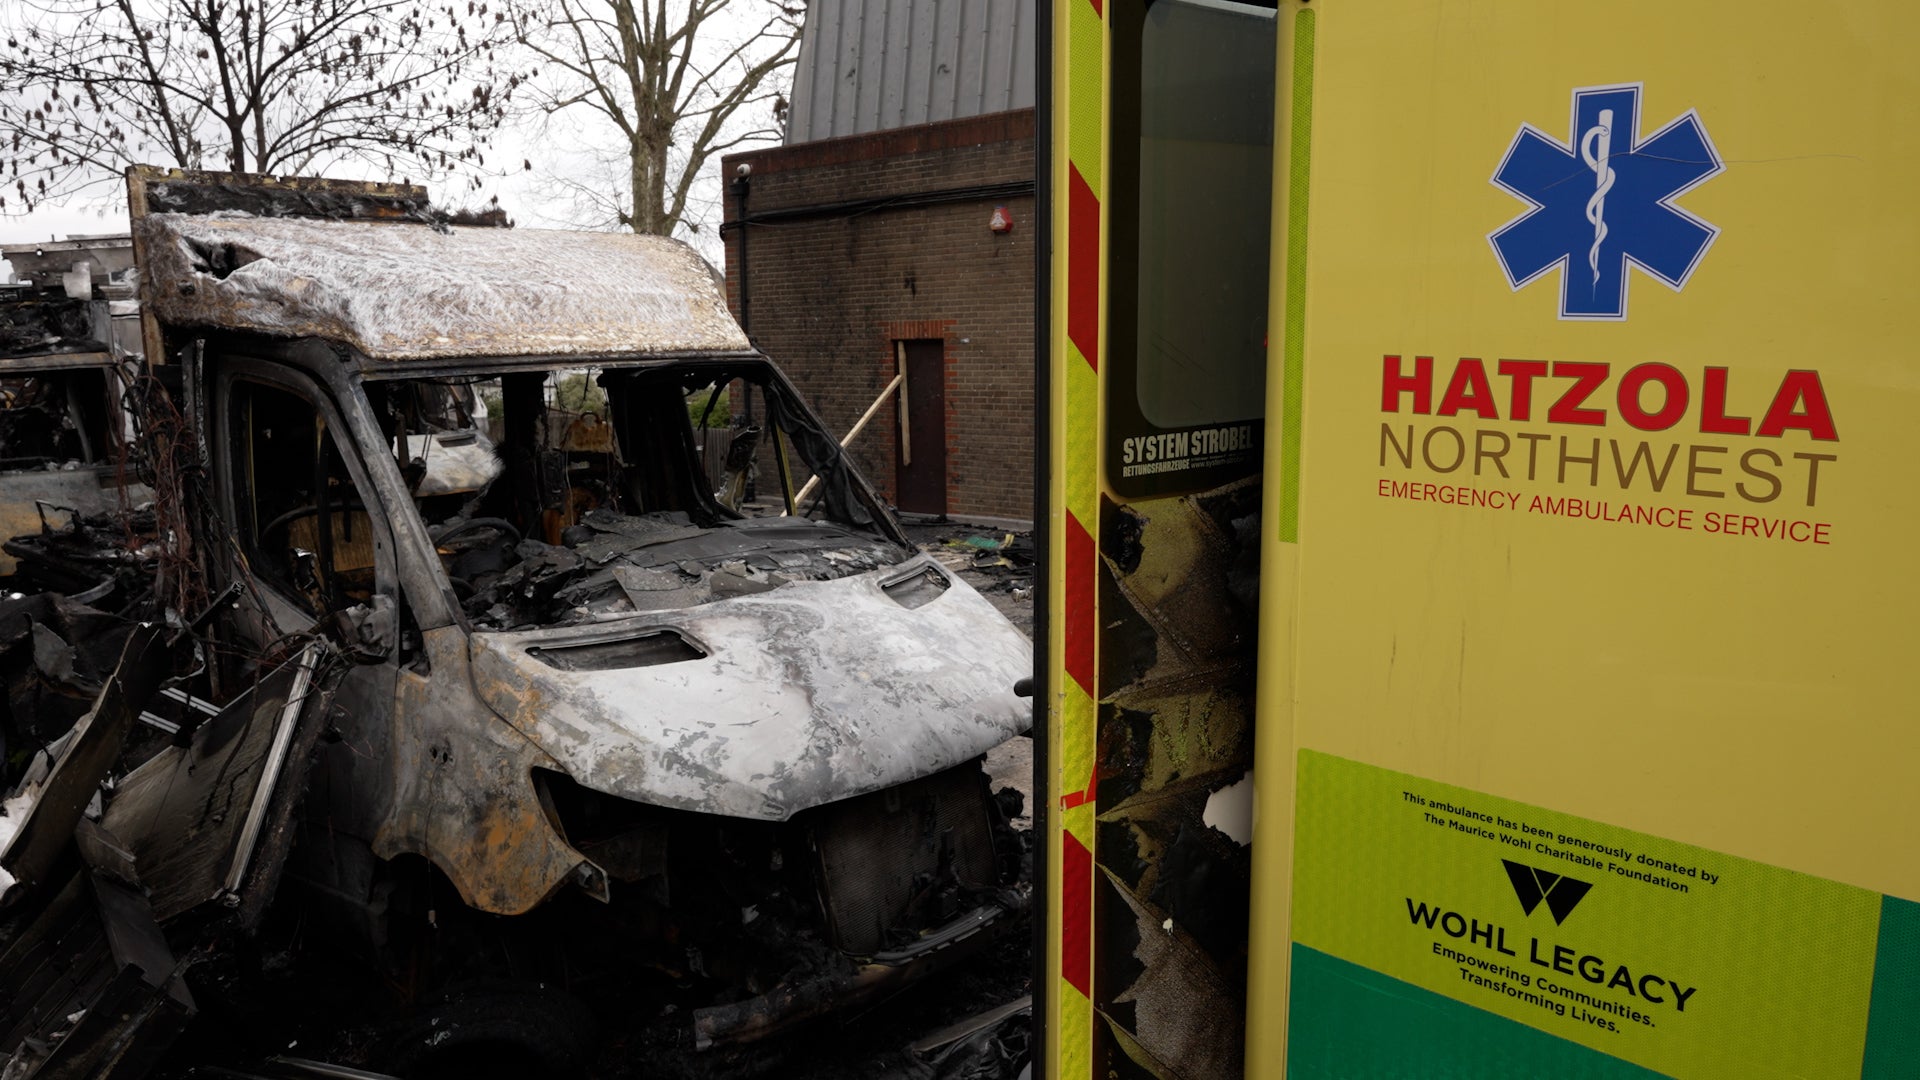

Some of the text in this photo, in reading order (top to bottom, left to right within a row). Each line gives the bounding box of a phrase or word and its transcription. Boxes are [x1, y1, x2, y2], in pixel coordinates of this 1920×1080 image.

[1381, 355, 1840, 442] HATZOLA
[1123, 425, 1253, 464] SYSTEM STROBEL
[1123, 459, 1190, 477] RETTUNGSFAHRZEUGE
[1380, 423, 1837, 506] NORTHWEST
[1379, 480, 1831, 544] EMERGENCY AMBULANCE SERVICE
[1403, 792, 1718, 884] This ambulance has been generously donated by
[1425, 813, 1688, 893] The Maurice Wohl Charitable Foundation
[1406, 898, 1696, 1012] WOHL LEGACY
[1433, 943, 1655, 1027] Empowering Communities.
[1460, 968, 1619, 1033] Transforming Lives.
